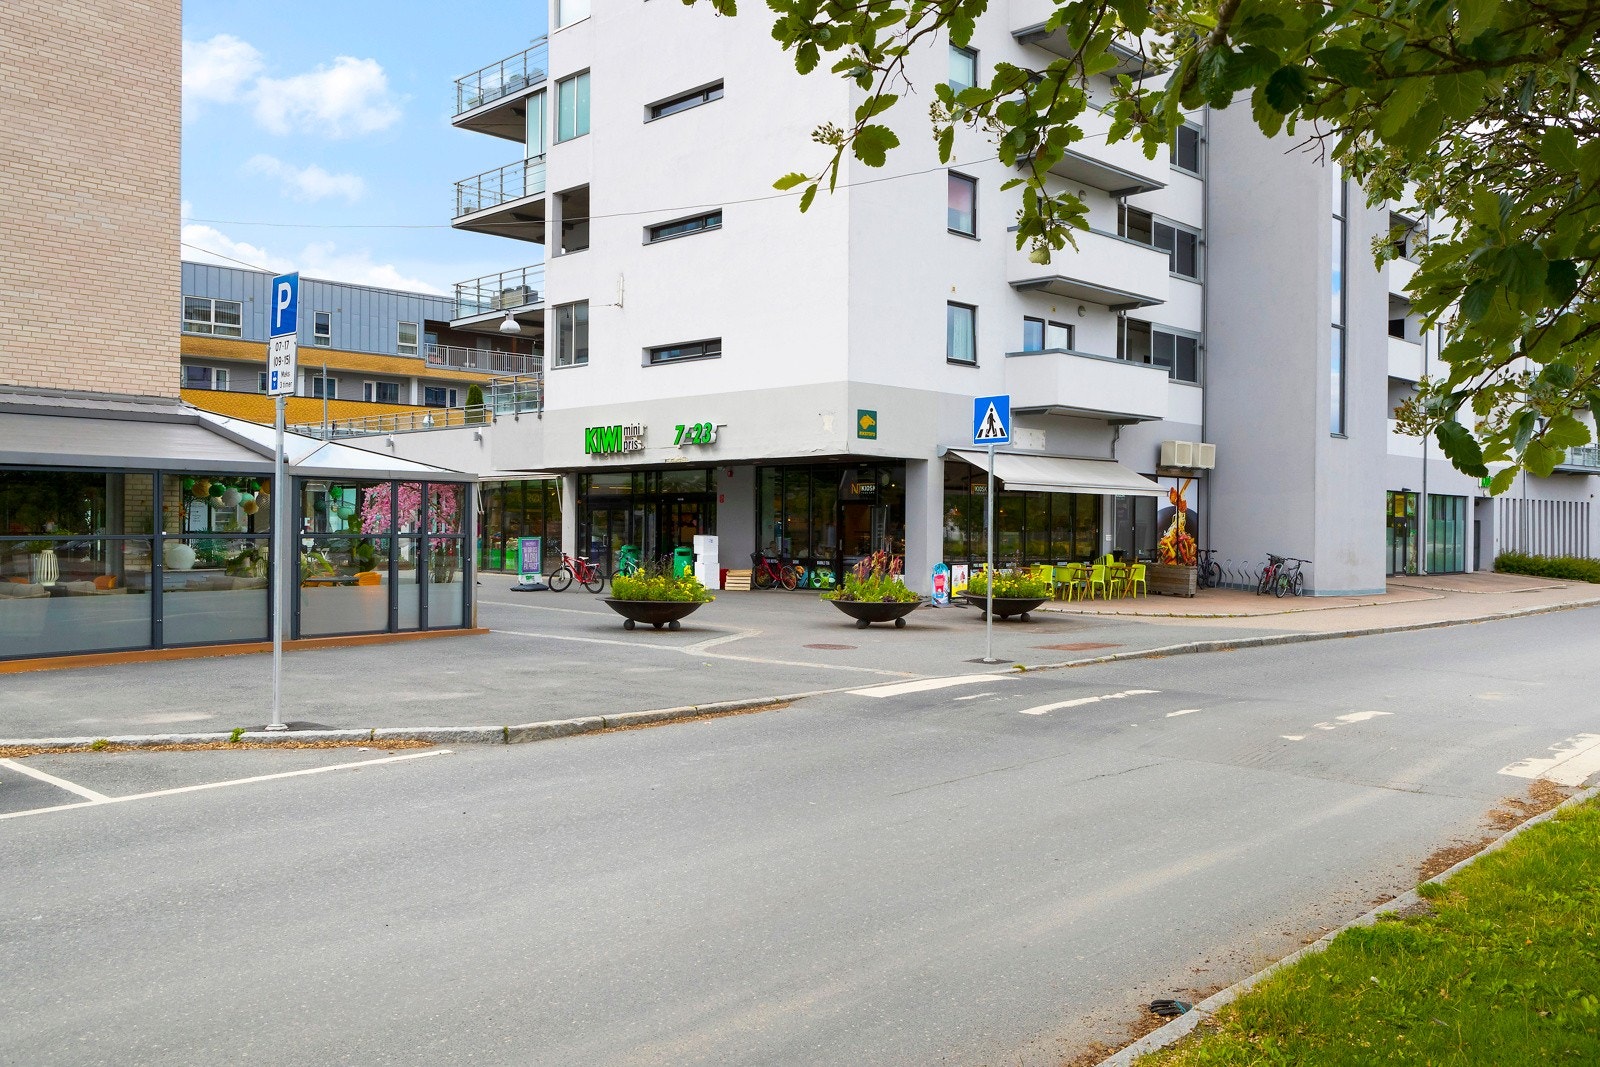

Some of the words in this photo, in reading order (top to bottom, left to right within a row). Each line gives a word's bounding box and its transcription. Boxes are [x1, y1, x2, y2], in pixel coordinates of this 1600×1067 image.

[277, 282, 291, 328] P
[275, 340, 290, 352] 07-17
[273, 354, 291, 367] (09-15)
[623, 423, 641, 436] mini
[585, 425, 622, 454] KIWI
[623, 438, 639, 452] pris
